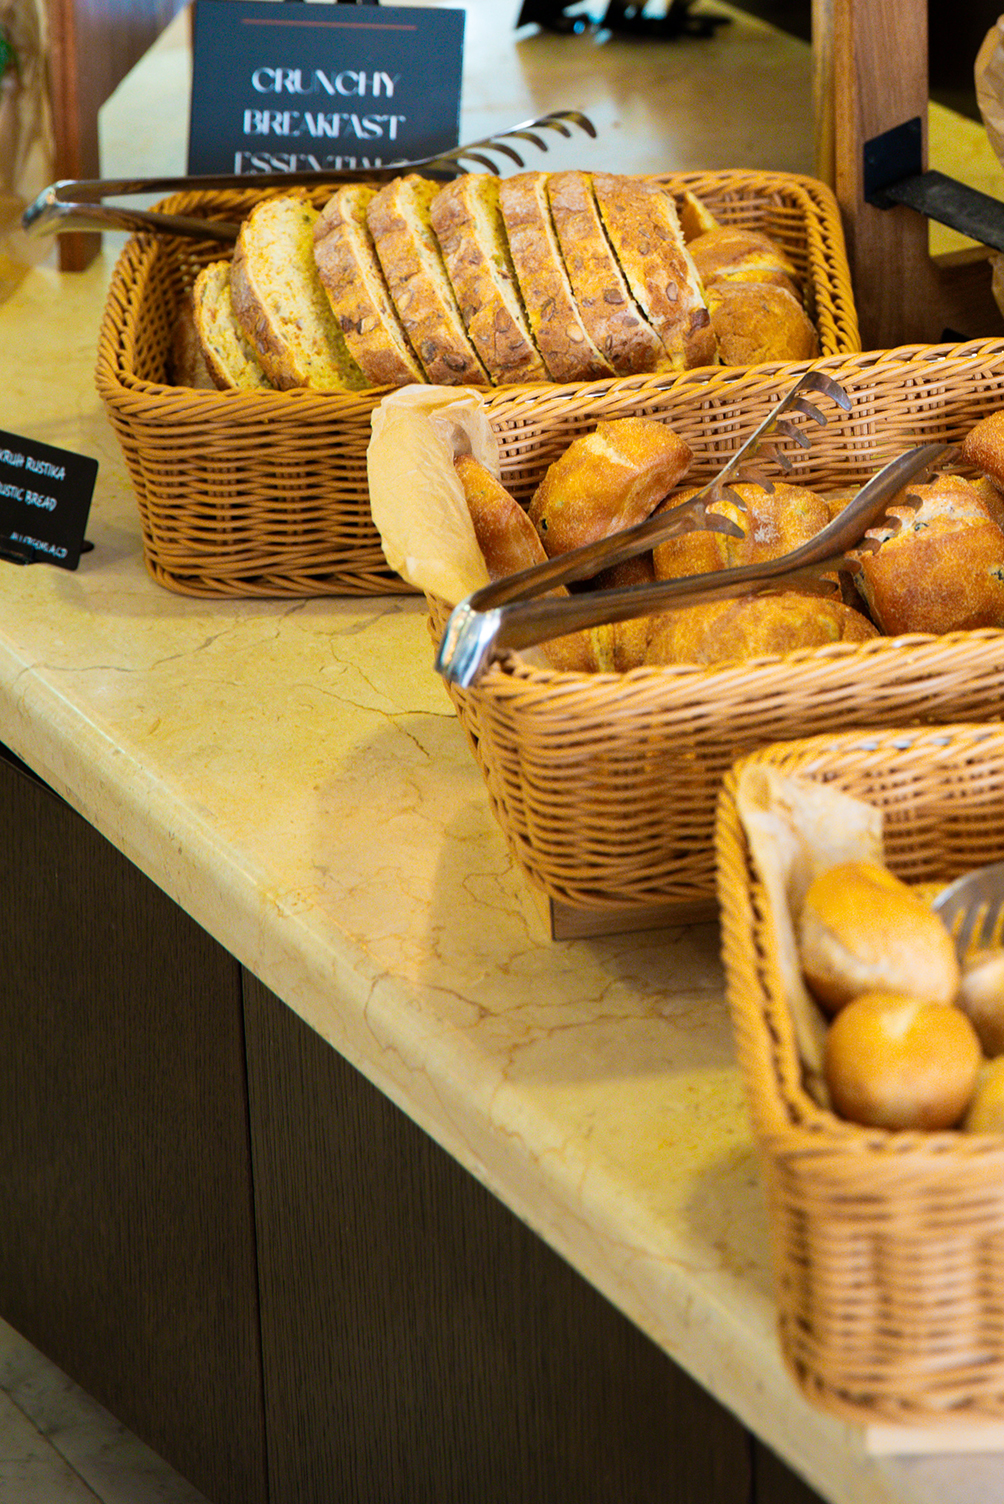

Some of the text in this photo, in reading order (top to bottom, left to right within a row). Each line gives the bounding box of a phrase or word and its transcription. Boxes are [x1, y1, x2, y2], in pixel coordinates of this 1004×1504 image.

[251, 66, 400, 98] CRUNCHY
[243, 108, 407, 141] BREAKFAST
[25, 456, 66, 481] RUSTIKA
[0, 481, 57, 512] USTIC BREAD
